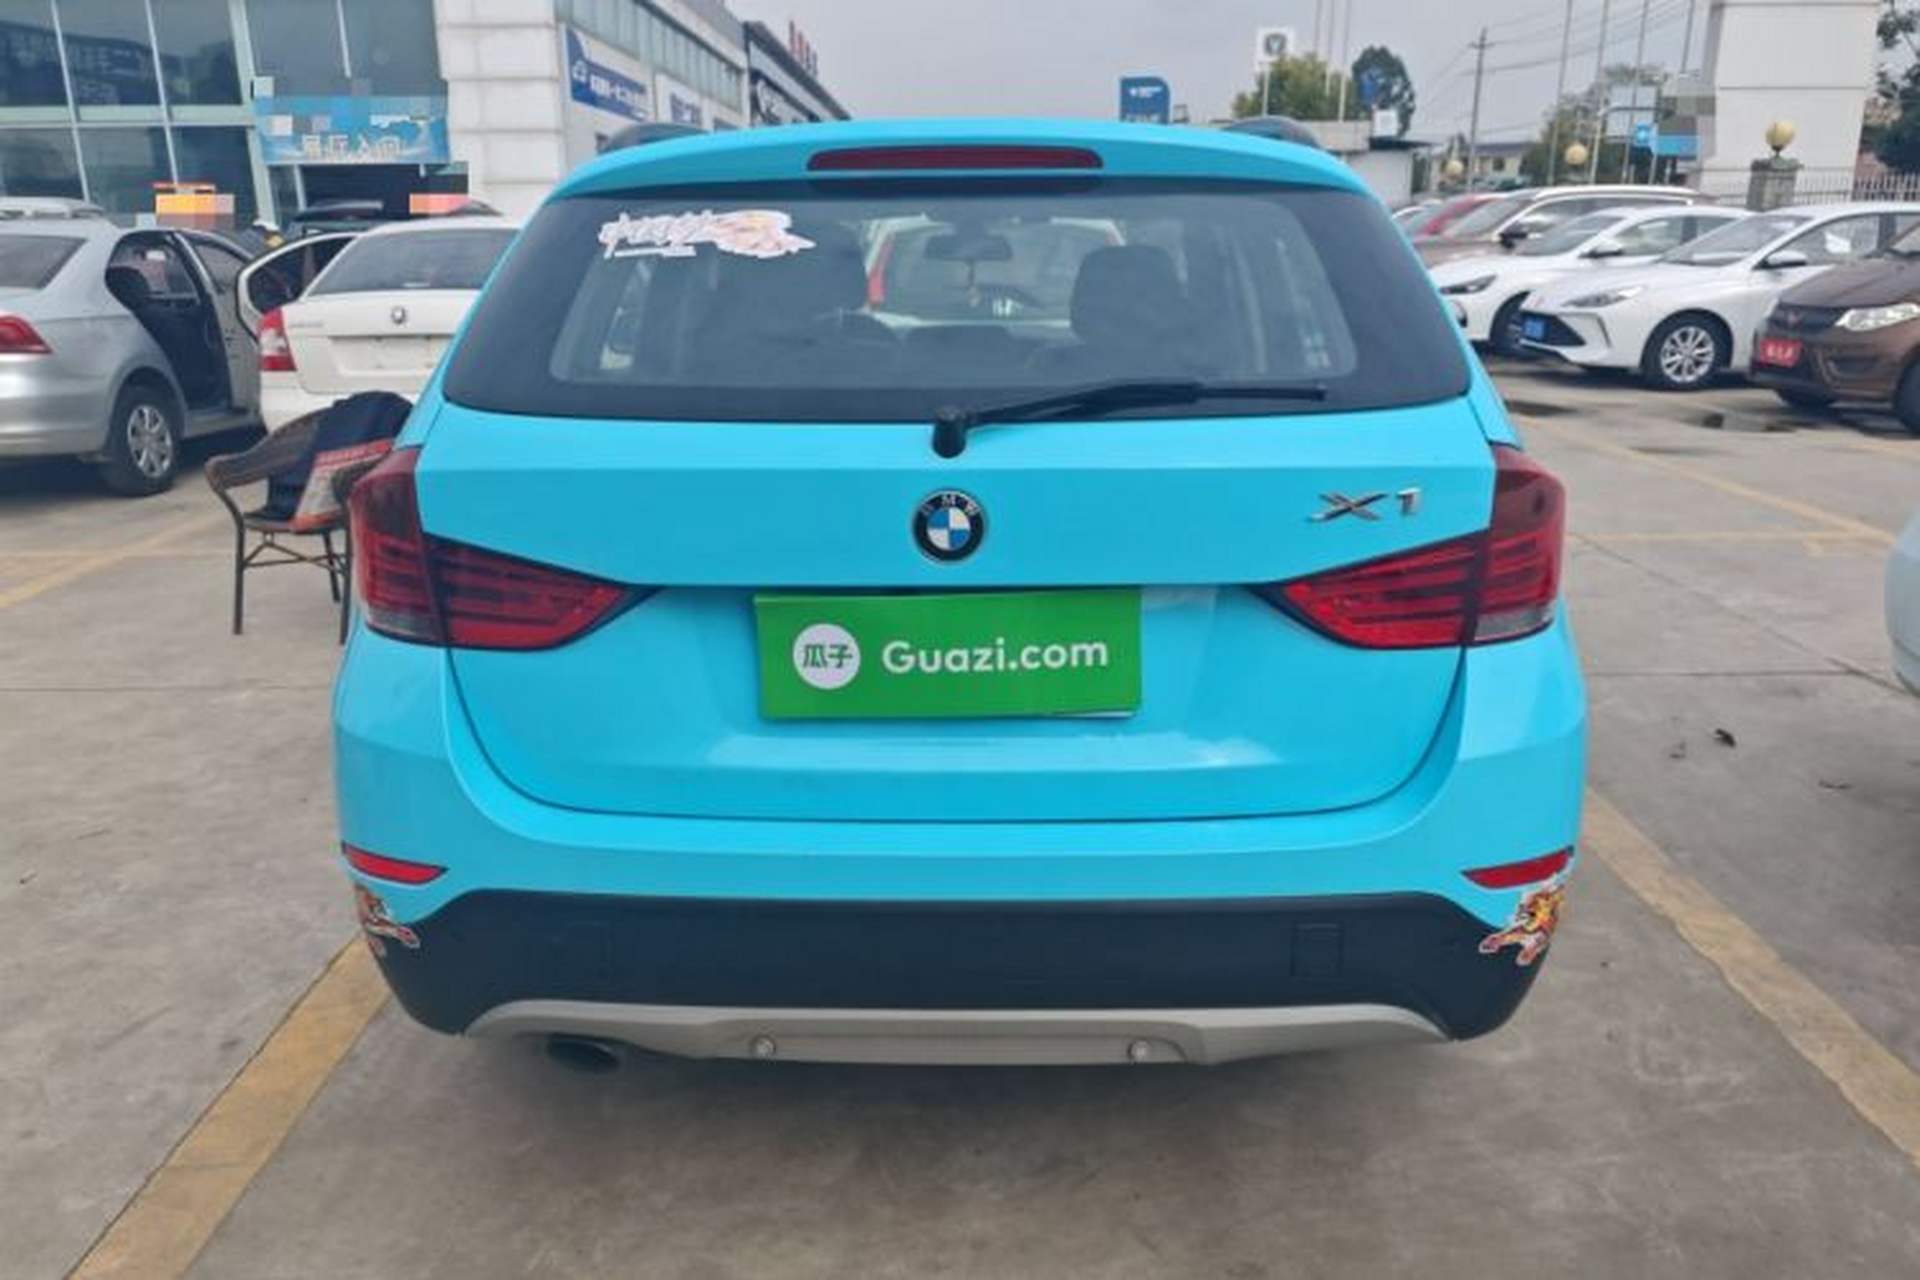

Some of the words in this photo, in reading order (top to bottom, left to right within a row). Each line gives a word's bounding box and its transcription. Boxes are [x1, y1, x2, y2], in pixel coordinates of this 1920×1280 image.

[1305, 487, 1420, 522] X1
[803, 643, 853, 669] 瓜子
[882, 637, 1108, 675] Guazi.com
